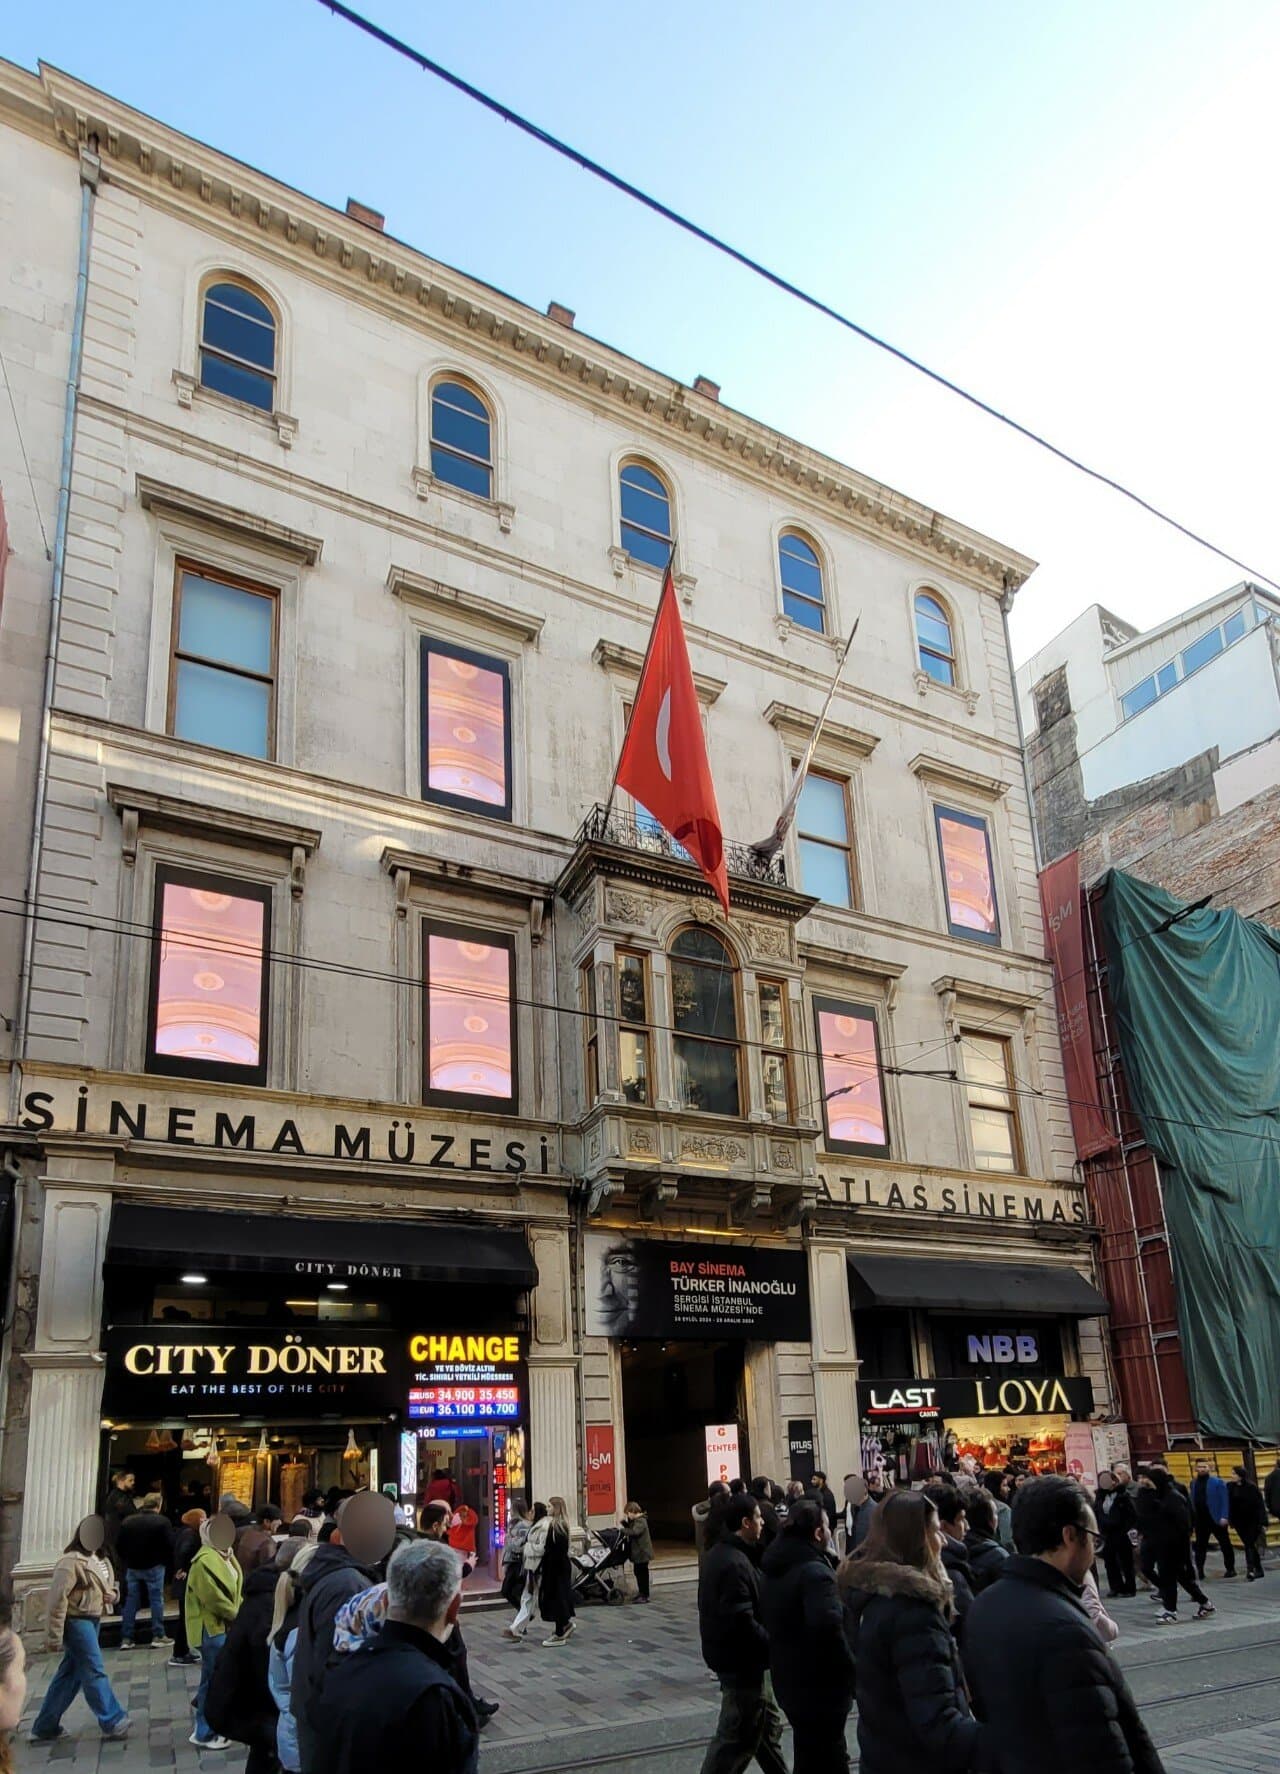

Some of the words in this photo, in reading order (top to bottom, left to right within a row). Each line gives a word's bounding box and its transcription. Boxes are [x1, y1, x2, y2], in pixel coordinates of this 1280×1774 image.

[22, 1086, 305, 1154] SİNEMA
[334, 1120, 548, 1174] MÜZESİ
[816, 1174, 928, 1211] ATLAS
[295, 1262, 336, 1275] CITY
[347, 1264, 402, 1278] DÖNER
[670, 1261, 695, 1274] BAY
[698, 1261, 746, 1276] SİNEMA
[671, 1275, 725, 1293] TÜRKER
[728, 1278, 796, 1296] İNANOĞLU
[674, 1294, 709, 1304] SERGİSİ
[712, 1295, 754, 1306] İSTANBUL
[674, 1303, 709, 1313] SİNEMA
[711, 1304, 763, 1315] MÜZESİ'NDE
[124, 1344, 235, 1375] CITY
[247, 1335, 387, 1375] DÖNER
[410, 1335, 520, 1361] CHANGE
[967, 1334, 1039, 1363] NBB
[171, 1384, 196, 1394] EAT
[202, 1384, 226, 1394] THE
[232, 1384, 262, 1394] BEST
[268, 1384, 285, 1394] OF
[290, 1384, 313, 1394] THE
[318, 1384, 346, 1394] CITY
[419, 1391, 435, 1399] USD
[438, 1390, 475, 1401] 34.900
[480, 1390, 515, 1400] 35.450
[870, 1388, 936, 1409] LAST
[420, 1406, 435, 1415] EUR
[438, 1403, 475, 1415] 36.100
[480, 1403, 515, 1415] 36.700
[707, 1443, 737, 1453] CENTER
[790, 1440, 813, 1451] ATLAS
